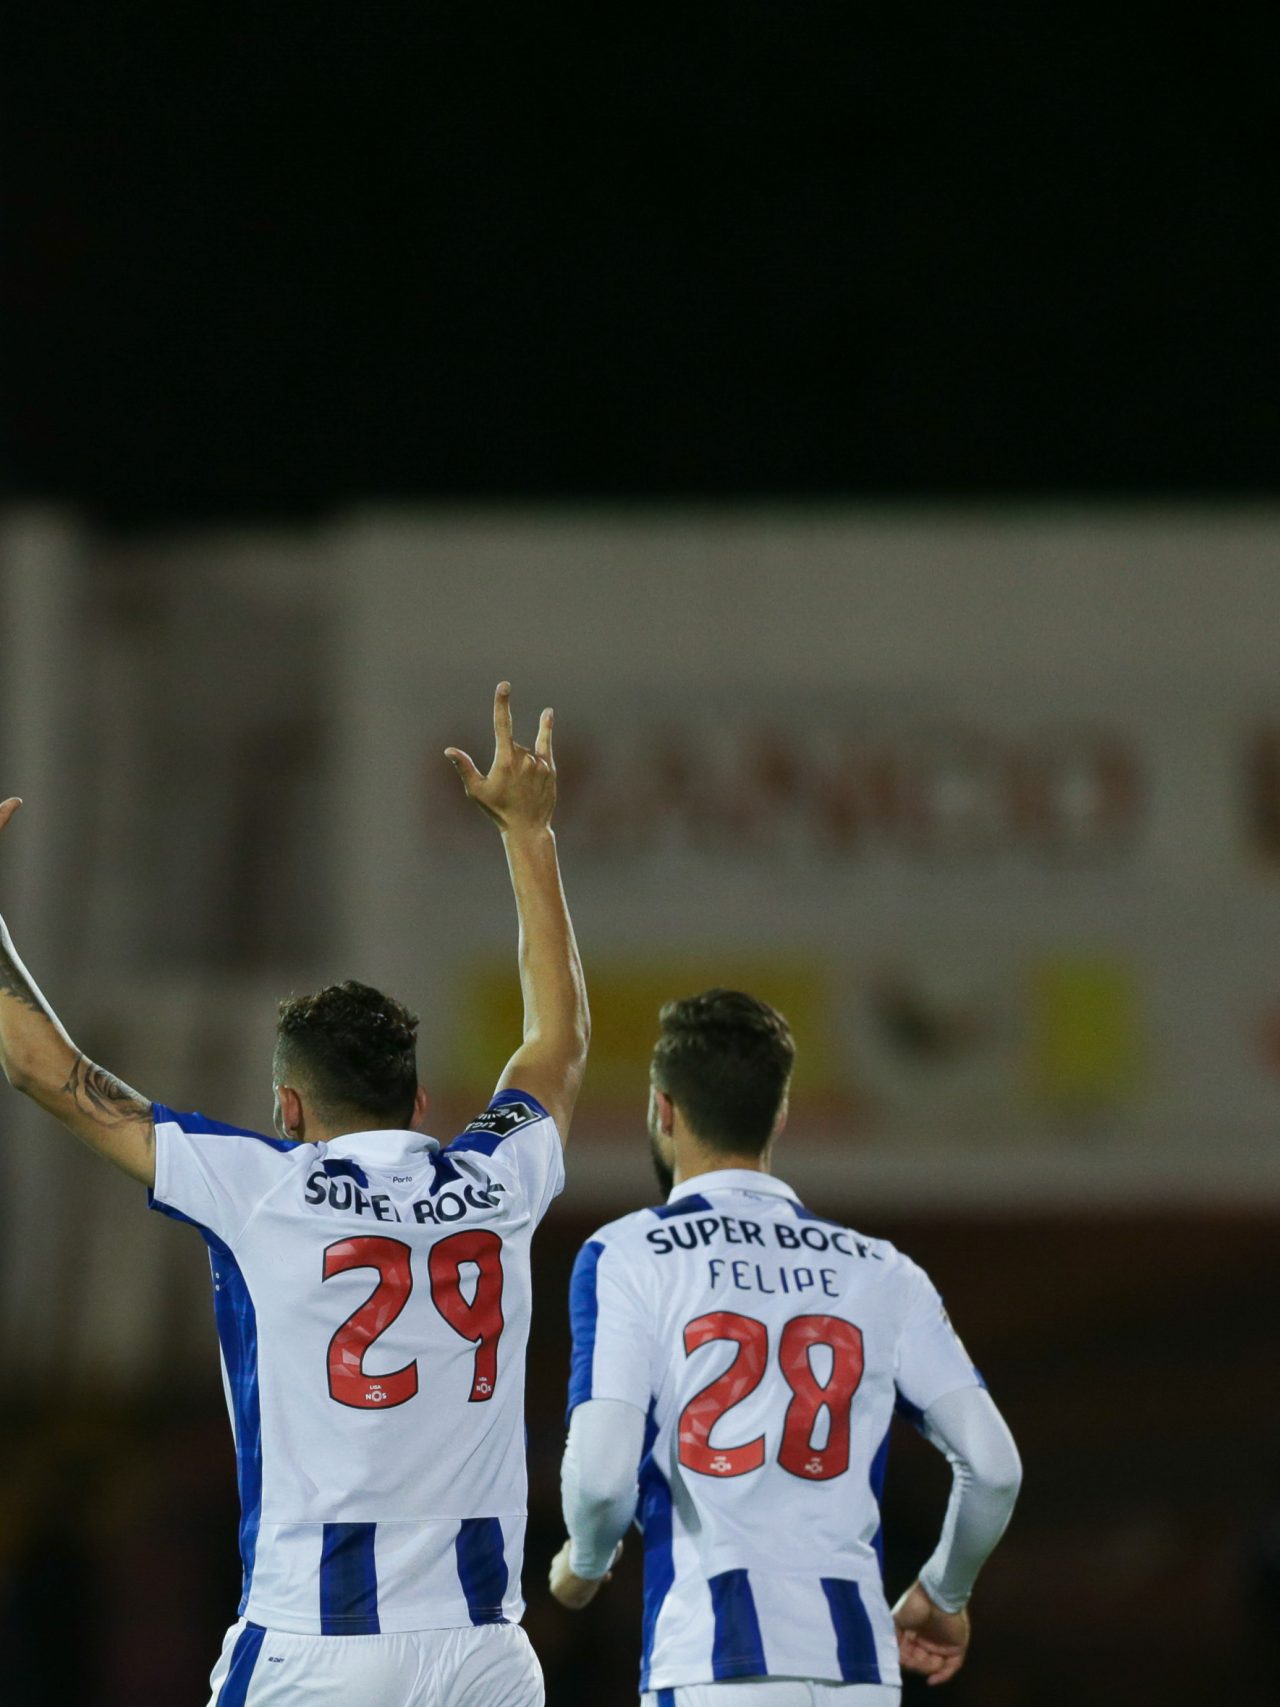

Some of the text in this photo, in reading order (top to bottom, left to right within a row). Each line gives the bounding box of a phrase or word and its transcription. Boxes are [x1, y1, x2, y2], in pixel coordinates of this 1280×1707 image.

[305, 1170, 401, 1224] SUPE
[392, 1175, 413, 1184] Porto
[646, 1216, 765, 1255] SUPER
[708, 1259, 840, 1297] FELIPE
[322, 1229, 504, 1410] 29
[365, 1390, 387, 1402] NOS
[476, 1383, 492, 1394] NOS
[677, 1311, 865, 1481] 28
